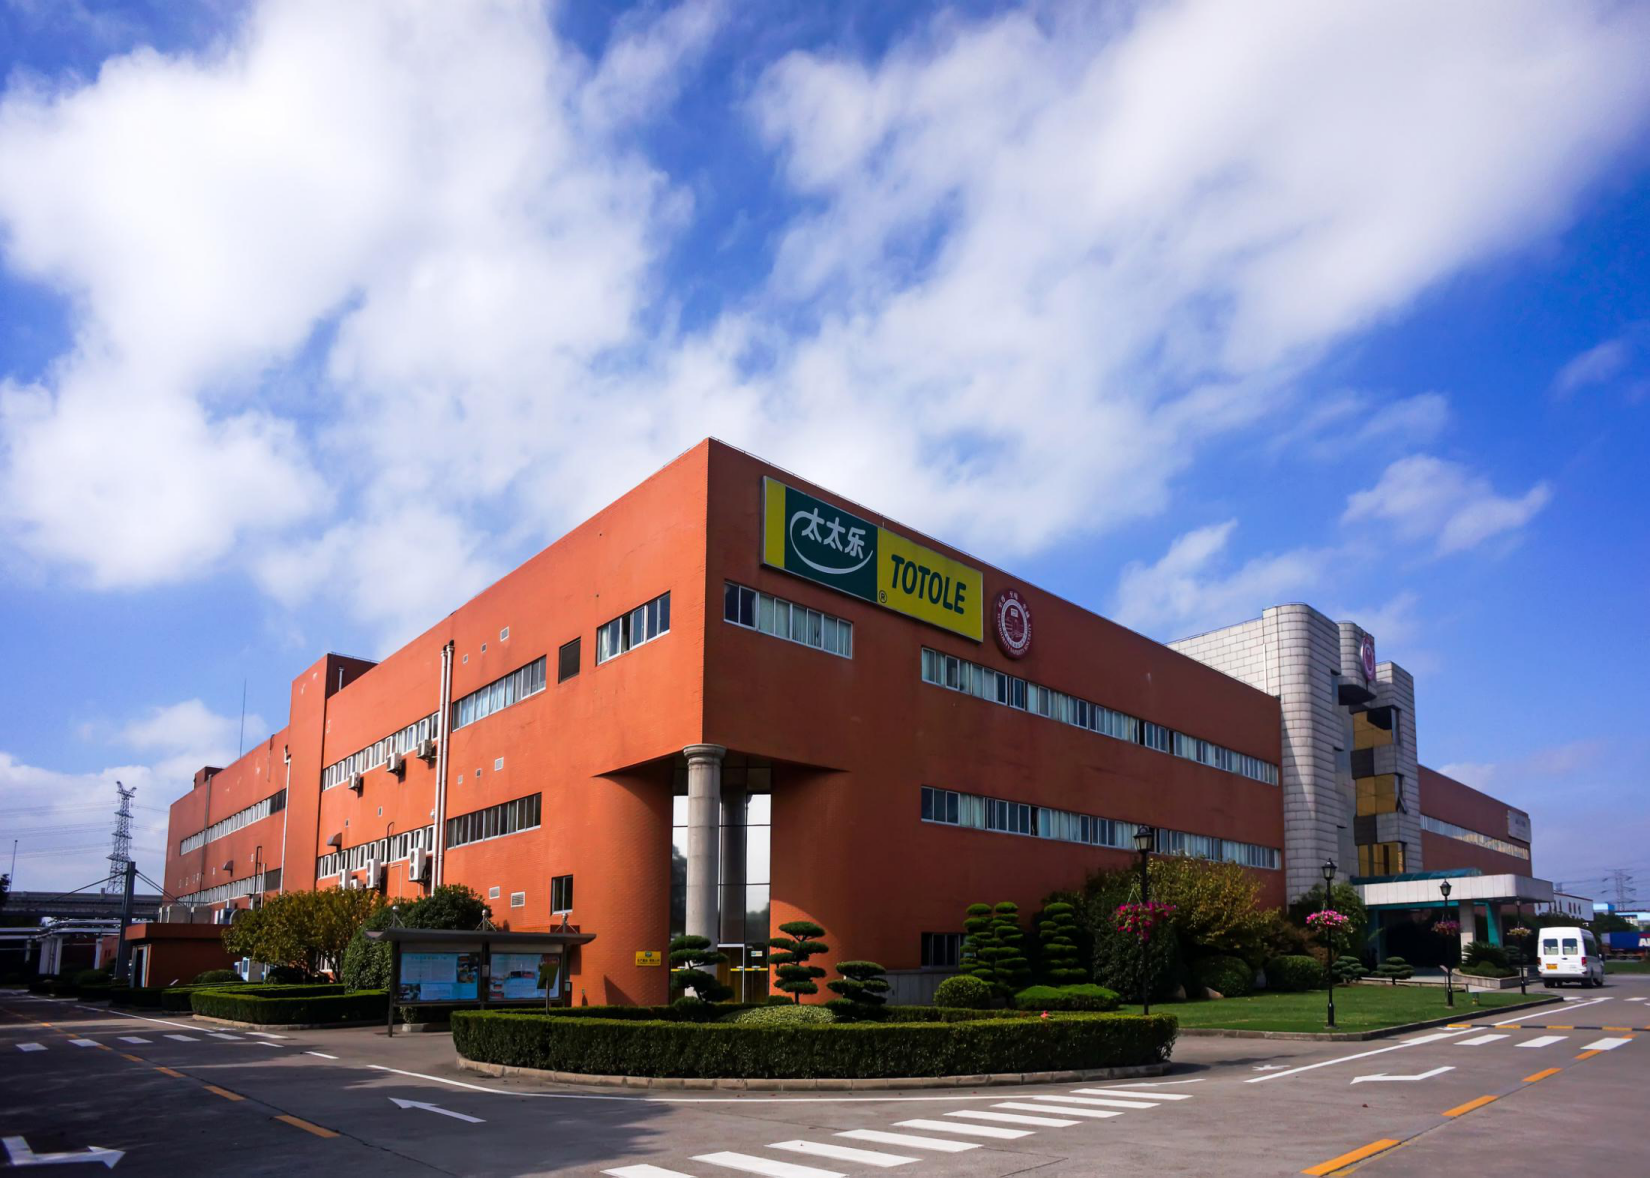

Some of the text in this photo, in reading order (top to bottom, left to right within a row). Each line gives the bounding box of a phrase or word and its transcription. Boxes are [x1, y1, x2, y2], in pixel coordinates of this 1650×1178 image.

[801, 507, 866, 560] 太太乐
[891, 554, 967, 615] TOTOLE
